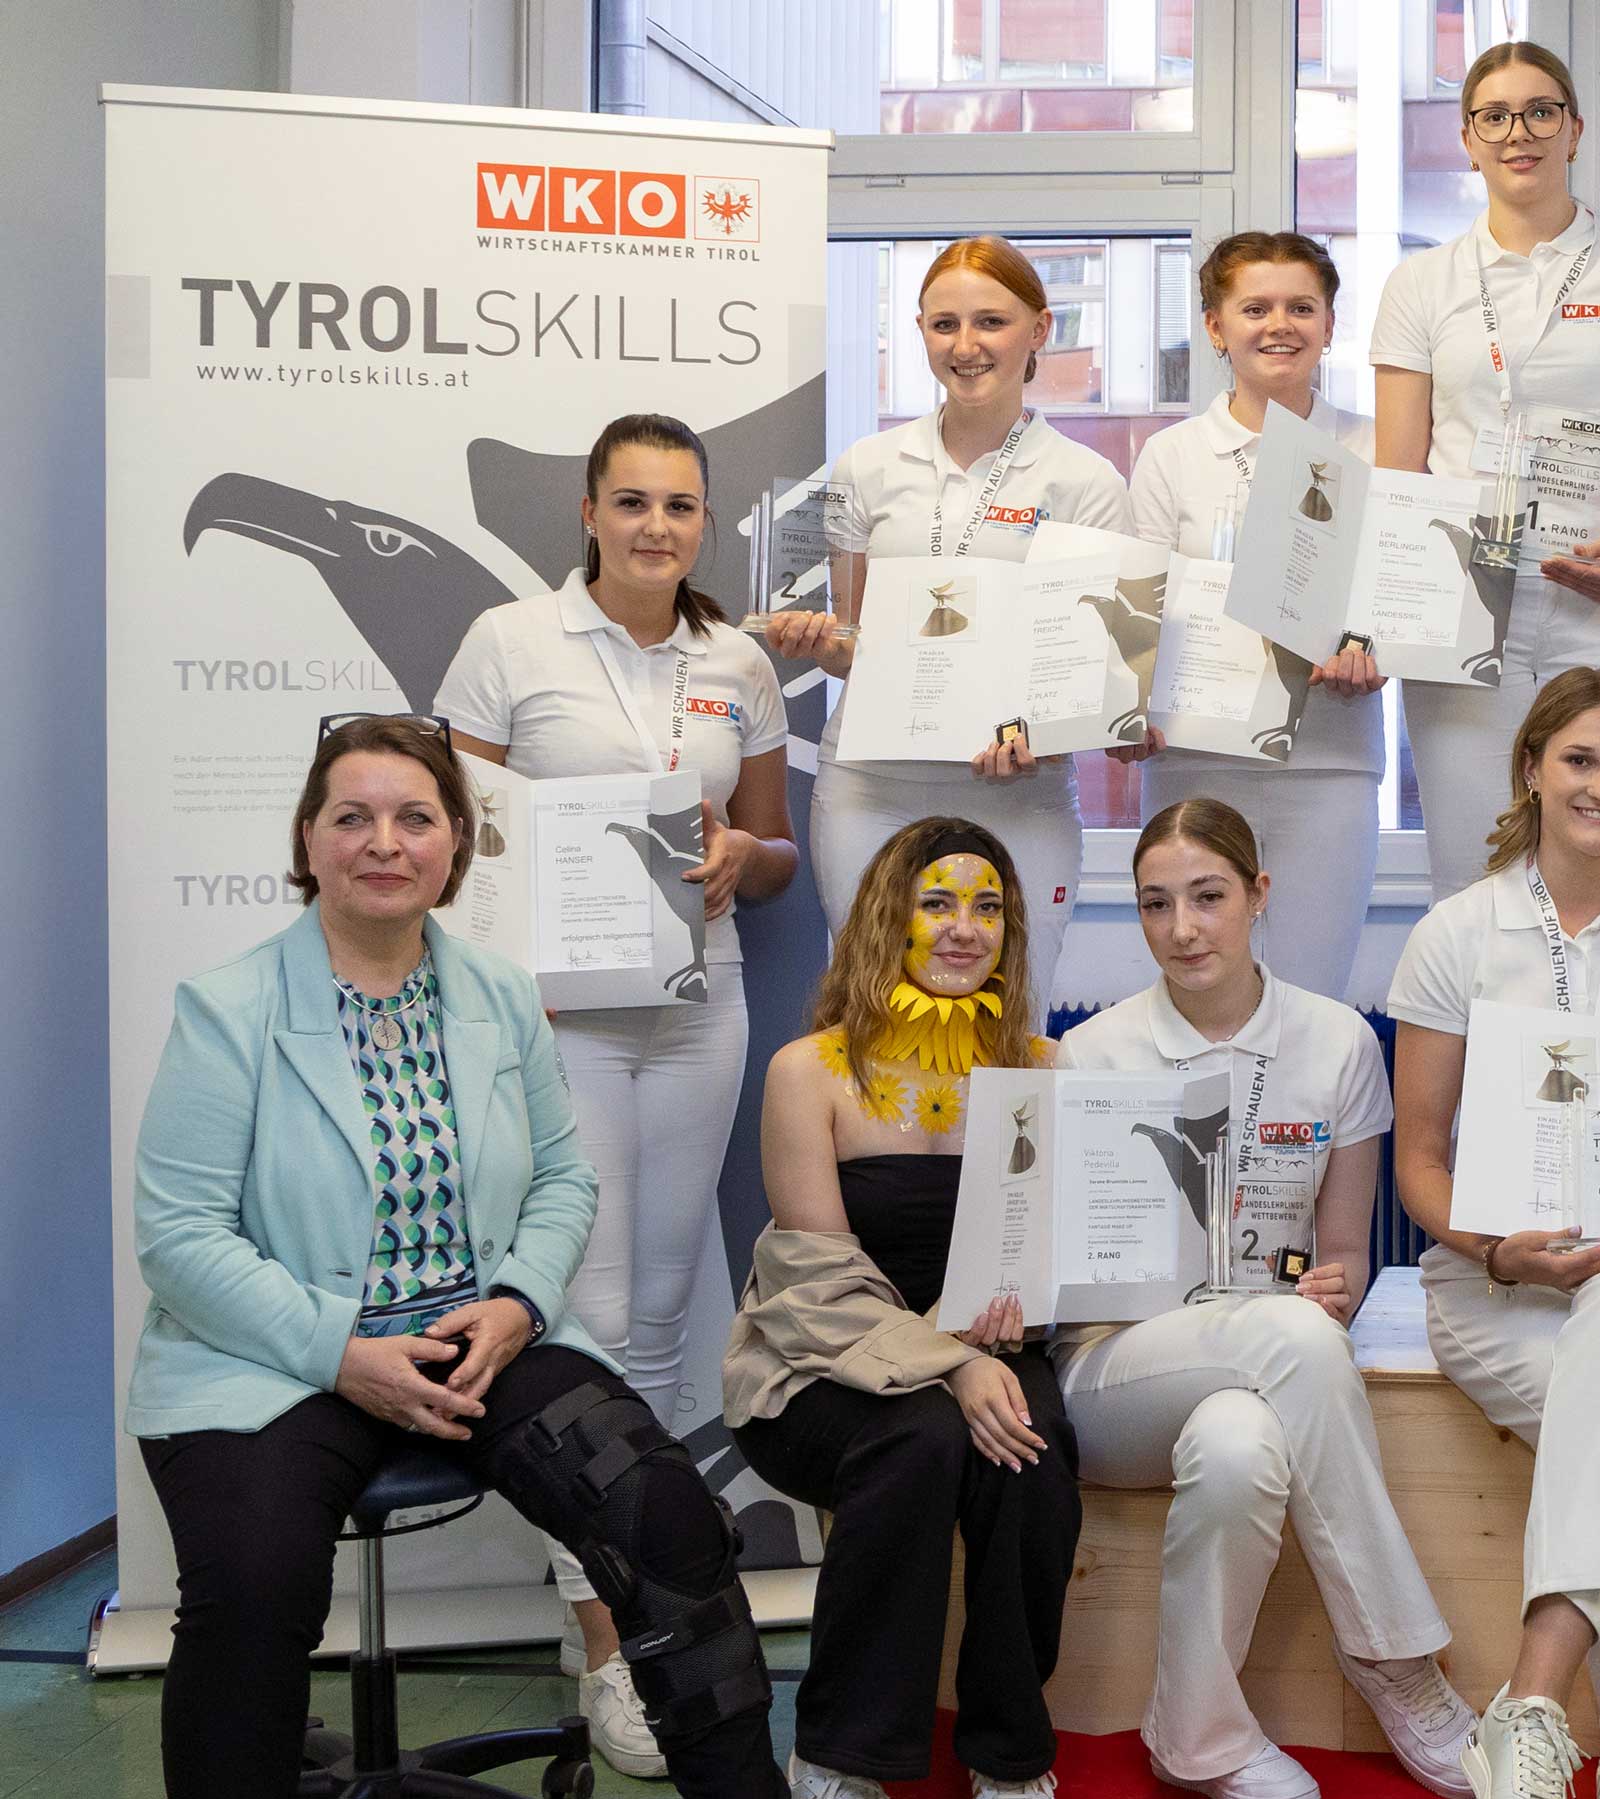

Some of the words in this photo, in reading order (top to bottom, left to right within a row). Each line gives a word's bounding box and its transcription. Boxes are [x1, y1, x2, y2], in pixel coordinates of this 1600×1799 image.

[479, 169, 680, 231] WKO
[476, 235, 696, 259] WIRTSCHAFTSKAMMER
[706, 247, 760, 262] TIROL
[181, 277, 761, 366] TYROLSKILLS
[197, 363, 470, 388] www.tyrolskills.at
[1562, 418, 1594, 432] WKO
[1529, 460, 1600, 480] TYROLSKILLS
[1527, 474, 1598, 492] LANDESLEHRLINGS-
[1537, 487, 1586, 500] WETTBEWERB
[1551, 523, 1589, 539] RANG
[173, 660, 400, 691] TYROLSKIL
[673, 660, 689, 715] SCHAUEN
[672, 715, 684, 739] WIR
[555, 855, 593, 864] HANSER
[1544, 915, 1562, 941] AUF
[1085, 1099, 1144, 1108] TYROLSKILLS
[1243, 1071, 1265, 1141] SCHAUEN
[1260, 1123, 1313, 1143] WKO
[1083, 1149, 1114, 1157] Viktoria
[1083, 1160, 1120, 1168] Pedevilla
[1239, 1185, 1307, 1196] TYROLSKILLS
[1241, 1200, 1308, 1210] LANDESLEHRLINGS-
[1251, 1212, 1297, 1221] WETTBEWERB
[1241, 1228, 1266, 1261] 2.
[1088, 1252, 1095, 1260] 2.
[1097, 1251, 1121, 1260] RANG
